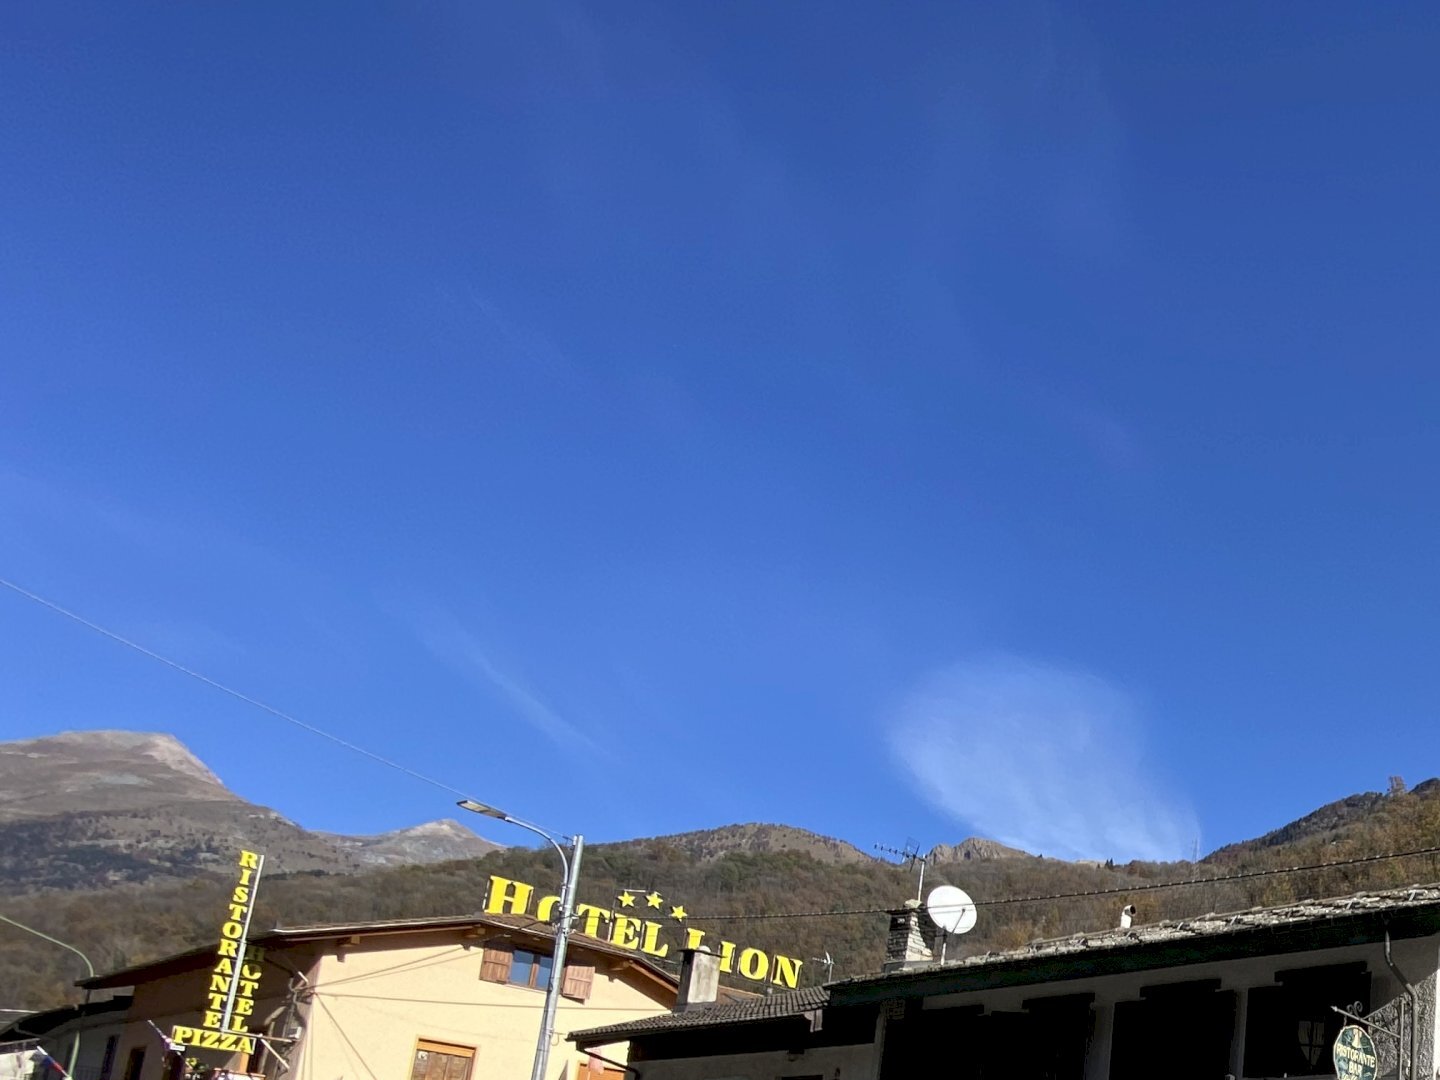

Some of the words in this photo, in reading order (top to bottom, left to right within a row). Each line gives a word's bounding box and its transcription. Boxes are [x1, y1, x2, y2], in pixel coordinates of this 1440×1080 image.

[203, 850, 258, 1028] RISTORANTE
[484, 875, 668, 958] HOTEL
[231, 945, 264, 1033] HOTEL
[173, 1027, 253, 1054] PIZZA
[1336, 1043, 1376, 1068] RISTORANTE
[1348, 1061, 1363, 1076] BAR
